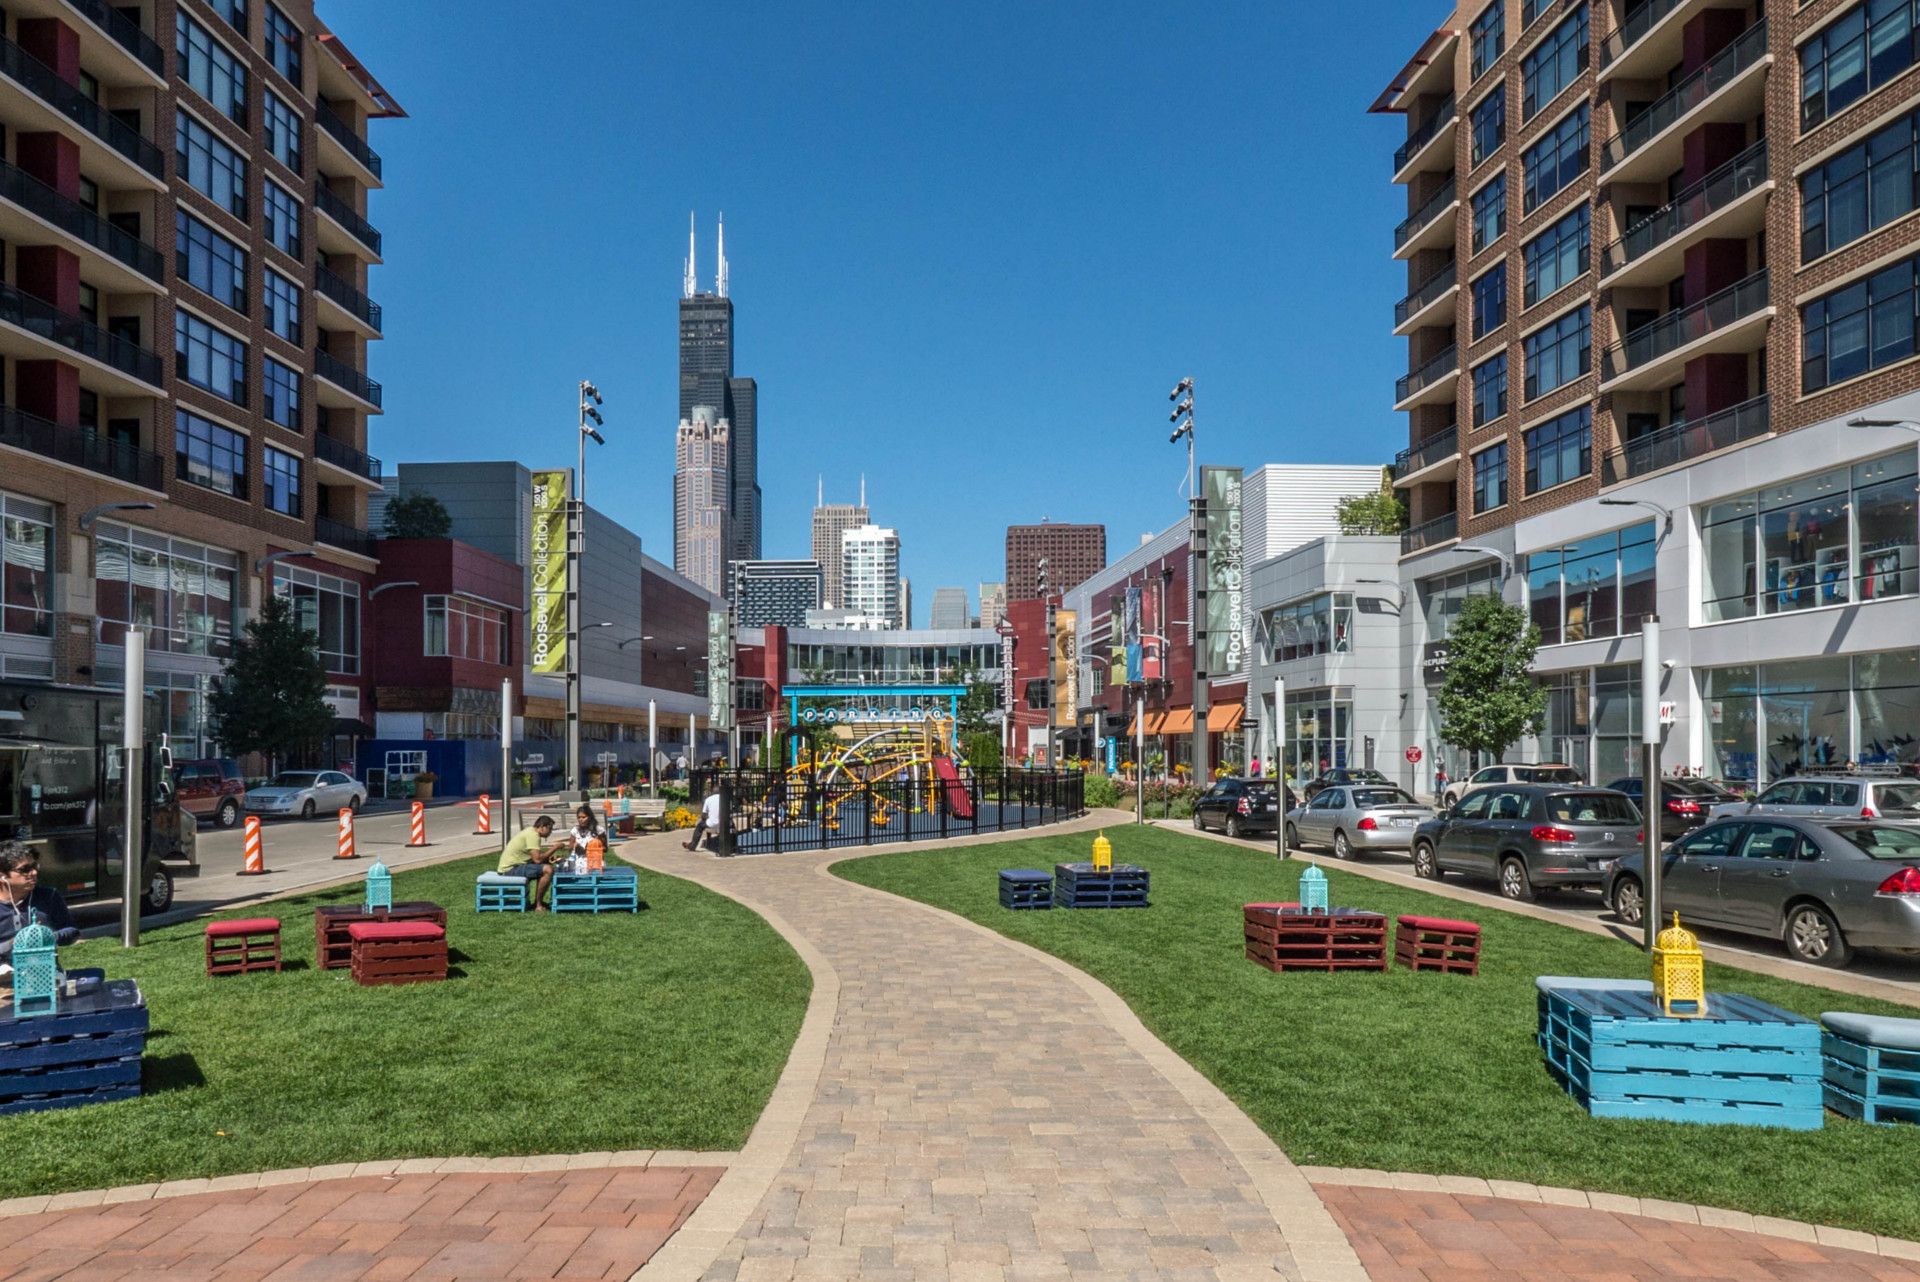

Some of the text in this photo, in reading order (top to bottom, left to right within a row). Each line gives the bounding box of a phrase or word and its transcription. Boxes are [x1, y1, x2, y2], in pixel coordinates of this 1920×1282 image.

[534, 484, 541, 494] W
[1226, 491, 1234, 505] 150
[533, 514, 548, 665] RooseveltCollection
[1226, 510, 1242, 664] RooseveltCollection
[804, 709, 944, 720] PARKING
